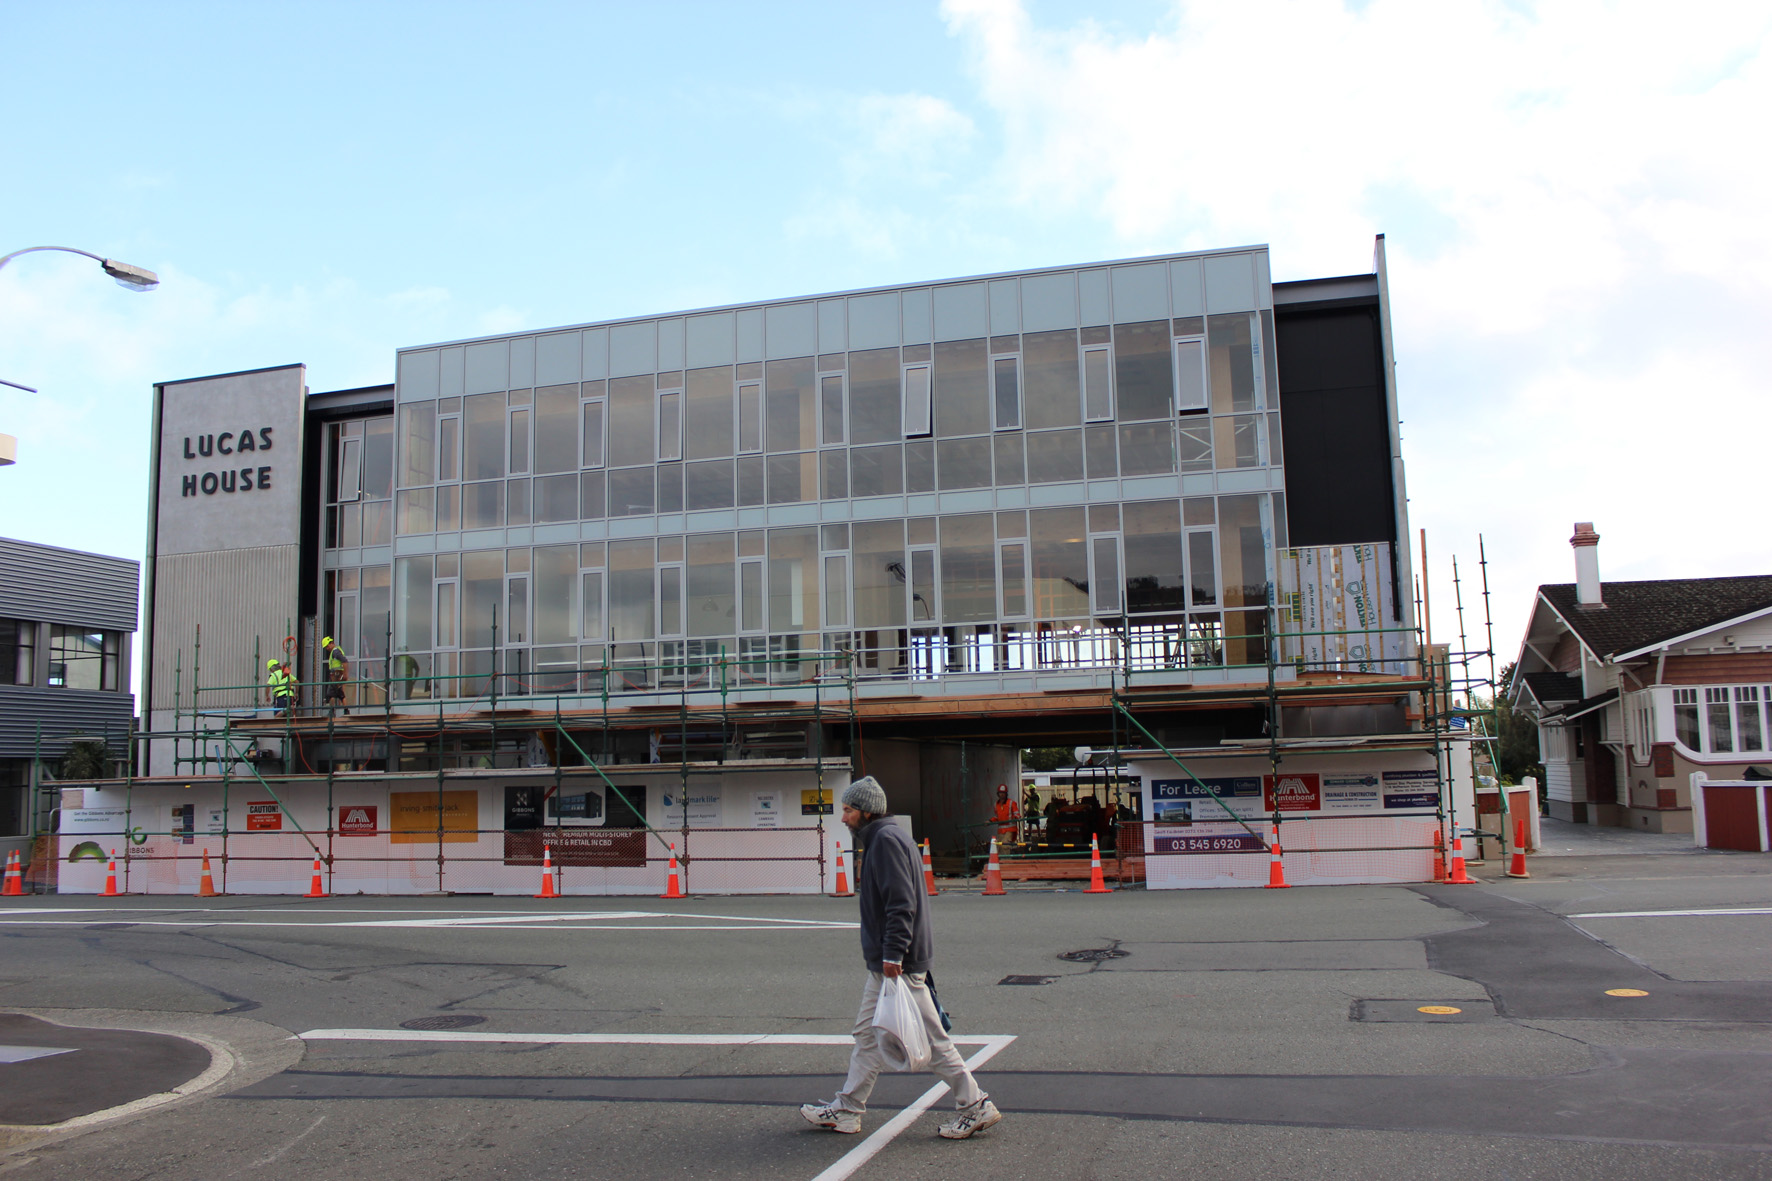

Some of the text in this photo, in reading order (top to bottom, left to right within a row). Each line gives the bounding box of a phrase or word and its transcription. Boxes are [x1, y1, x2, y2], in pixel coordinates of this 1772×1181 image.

[183, 427, 272, 459] LUCAS
[182, 466, 271, 497] HOUSE
[1160, 783, 1221, 796] For Lease
[249, 805, 279, 814] CAUTION!
[400, 803, 459, 814] irving smit jack
[1172, 838, 1241, 850] 03 545 6920
